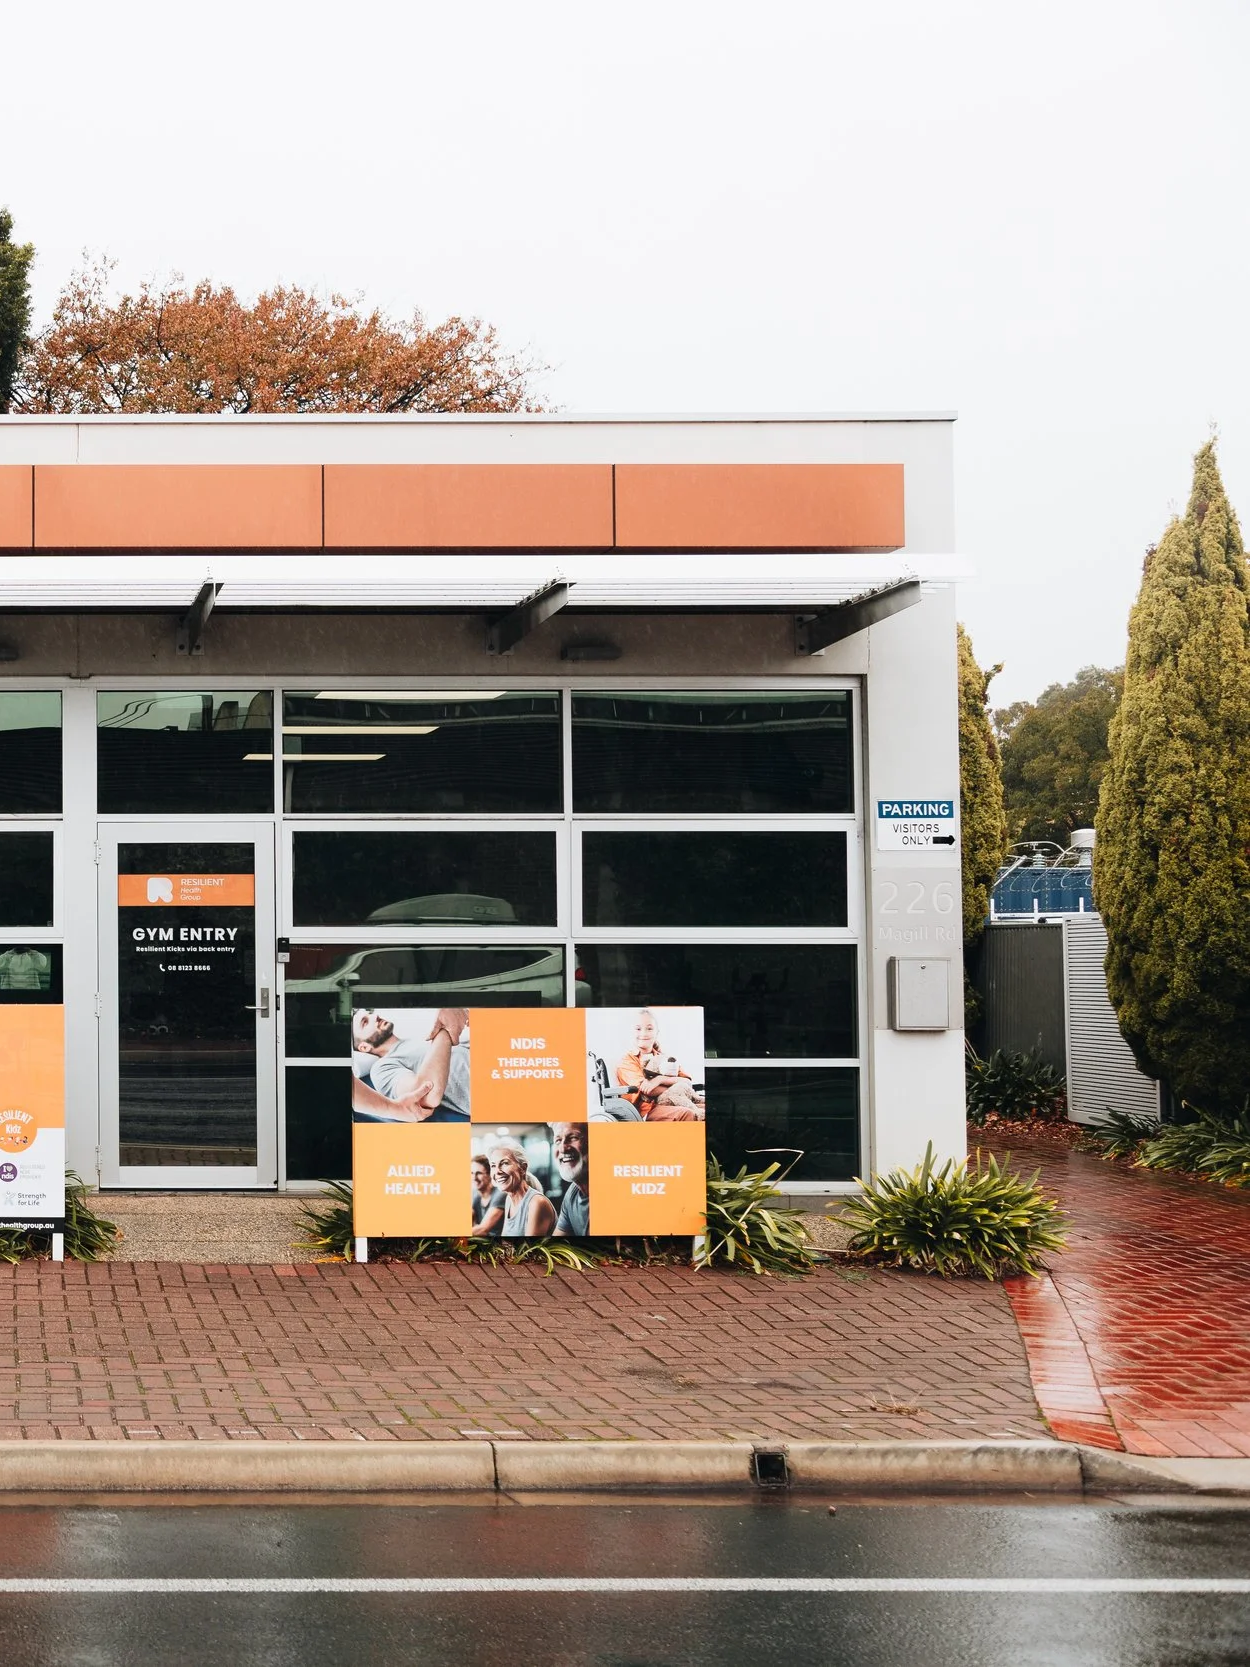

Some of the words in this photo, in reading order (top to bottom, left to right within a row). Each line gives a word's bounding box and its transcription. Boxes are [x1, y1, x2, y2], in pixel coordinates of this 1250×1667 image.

[882, 803, 950, 816] PARKING
[892, 823, 940, 833] VISITORS
[901, 836, 931, 845] ONLY
[181, 878, 225, 886] RESILIENT
[879, 880, 954, 914] 226
[132, 927, 174, 941] GYM
[179, 927, 238, 941] ENTRY
[879, 926, 928, 943] Magill
[935, 926, 956, 941] Rd
[510, 1037, 547, 1050] NDIS
[497, 1057, 560, 1068] THERAPIES
[491, 1069, 501, 1079] &
[502, 1069, 564, 1079] SUPPORTS
[5, 1123, 22, 1134] Kidz
[1, 1172, 14, 1180] ndis
[387, 1164, 435, 1177] ALLIED
[613, 1165, 684, 1177] RESILIENT
[385, 1182, 441, 1195] HEALTH
[631, 1182, 667, 1195] KIDZ
[17, 1192, 47, 1201] Strength
